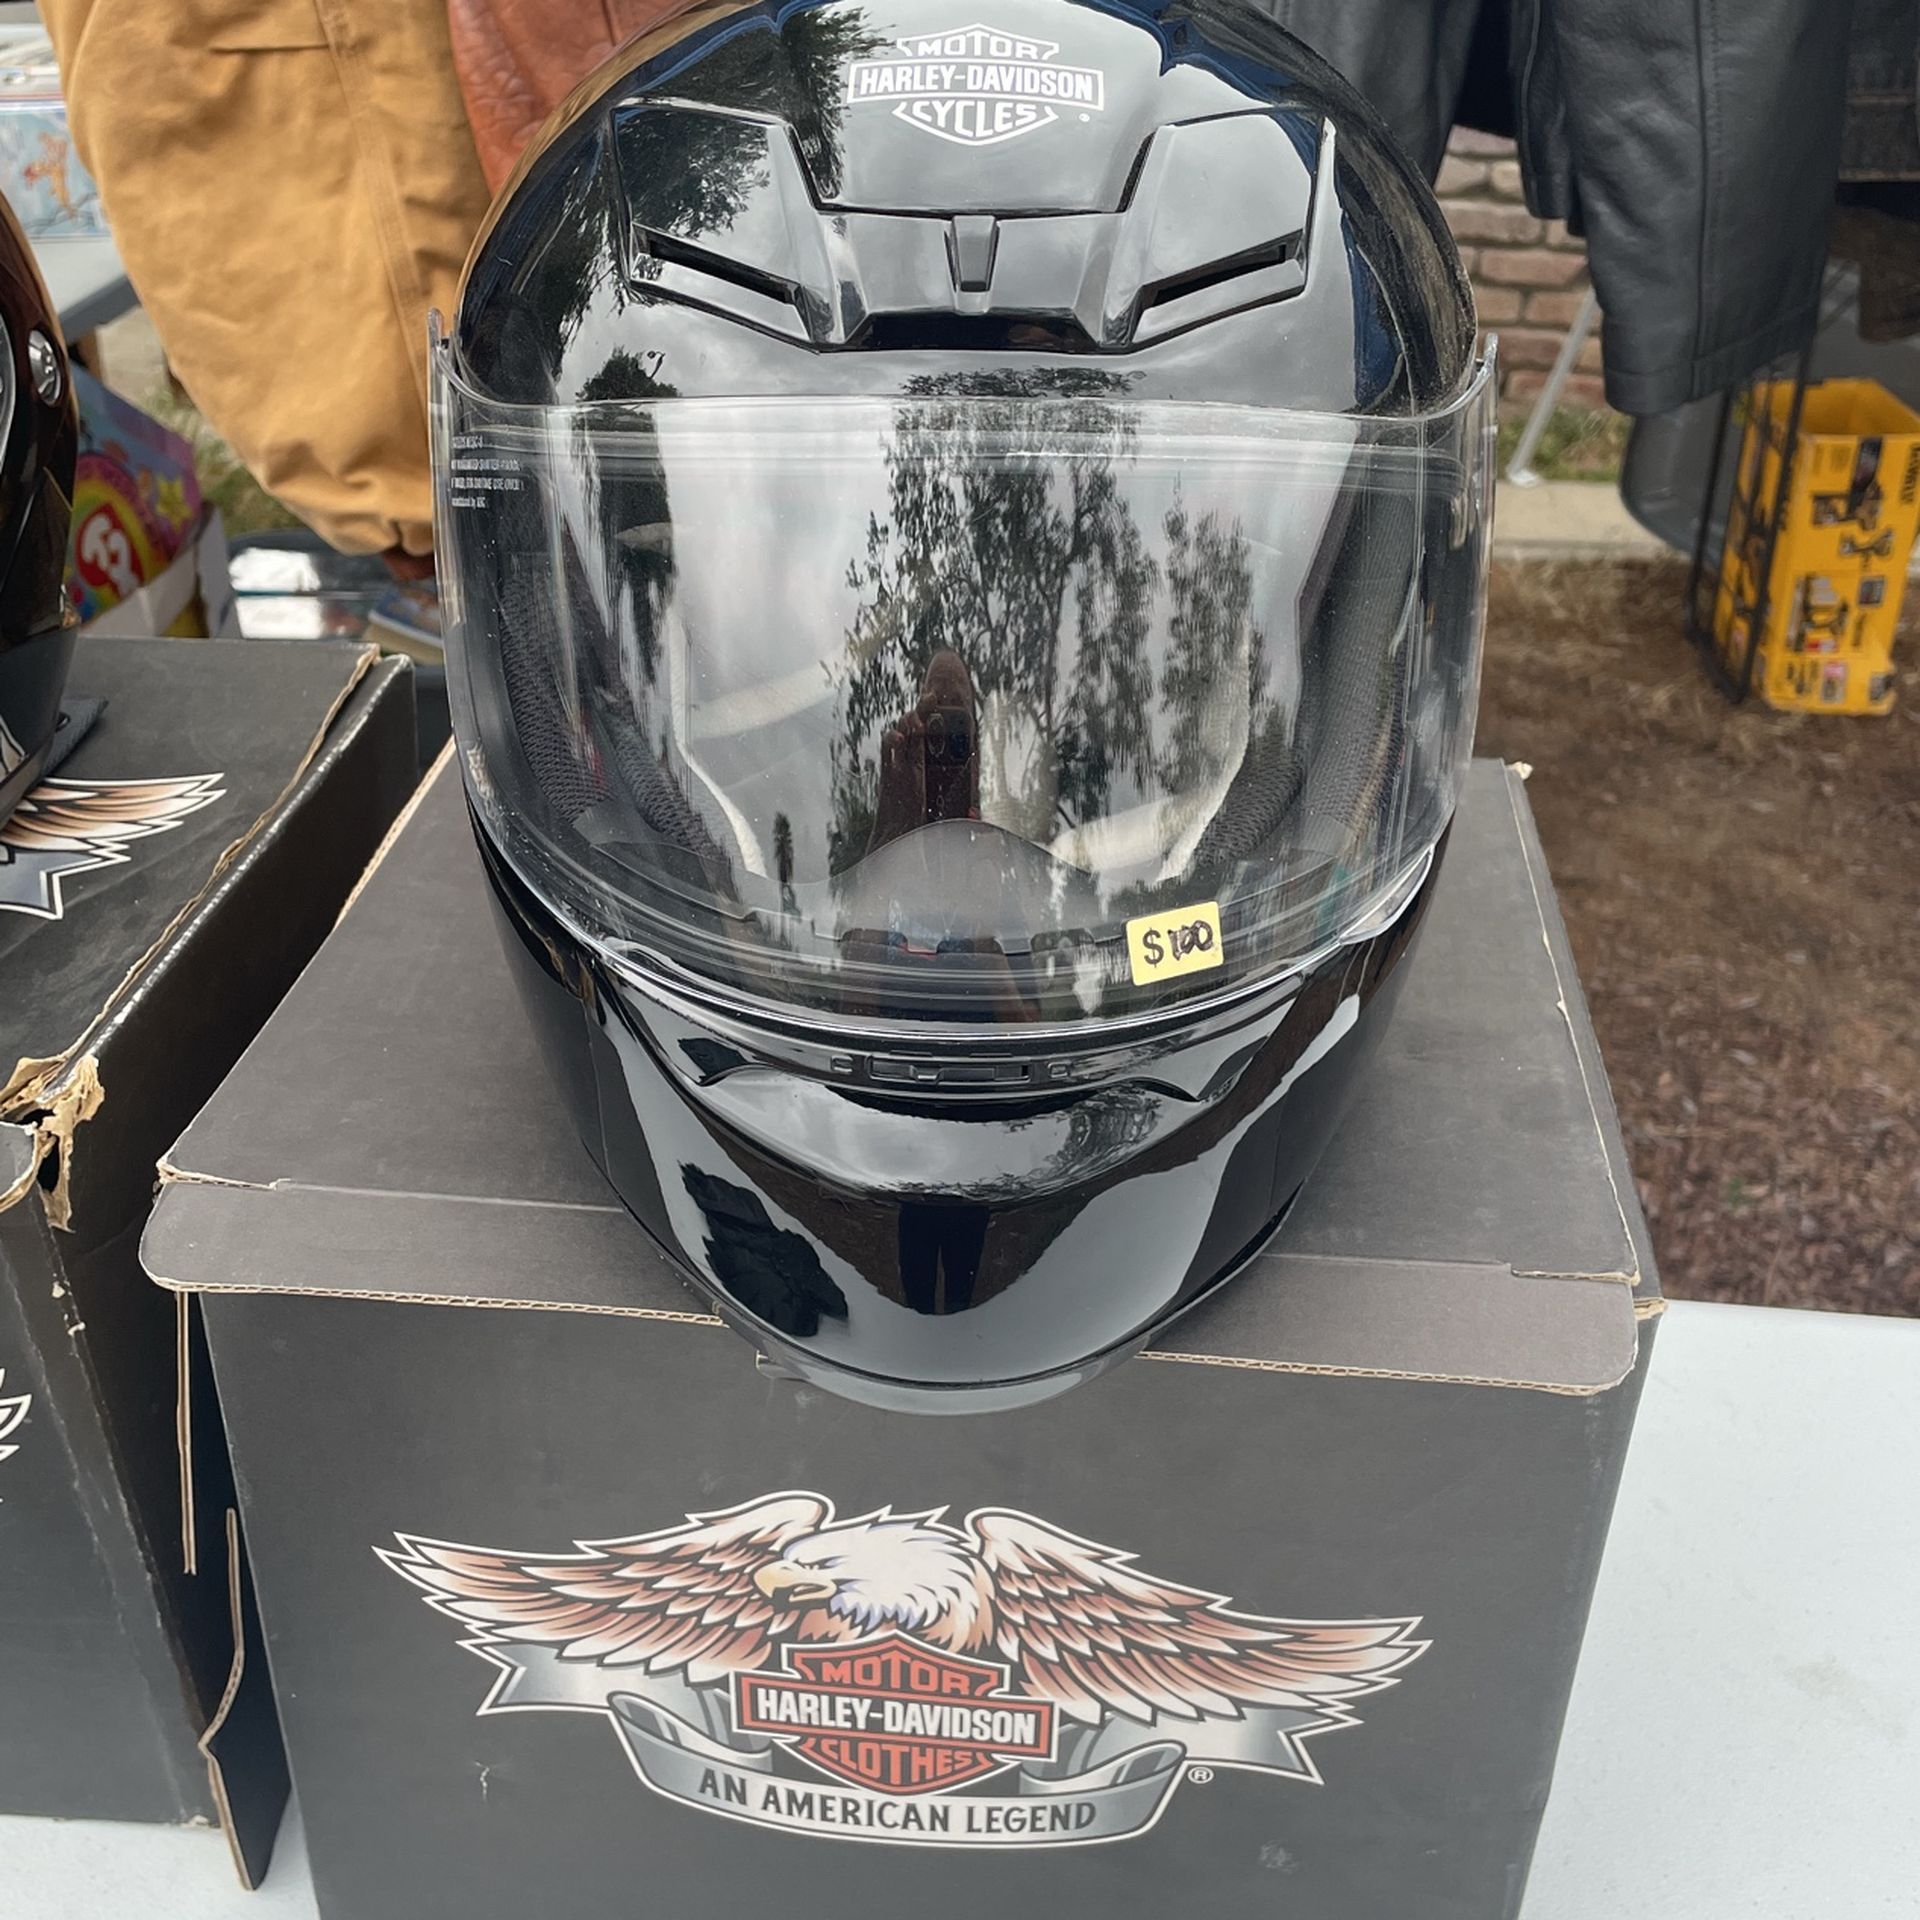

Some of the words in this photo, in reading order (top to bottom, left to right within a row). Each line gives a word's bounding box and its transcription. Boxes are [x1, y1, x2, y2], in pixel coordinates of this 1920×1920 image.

[917, 30, 1038, 58] MOTOR
[860, 64, 1093, 101] HARLEY-DAVIDSON
[911, 100, 1037, 138] CYCLES
[822, 1650, 970, 1695] MOTOR
[757, 1687, 1036, 1745] HARLEY-DAVIDSON
[820, 1738, 975, 1786] CLOTHES
[699, 1768, 748, 1805] AN
[761, 1784, 951, 1833] AMERICAN
[966, 1801, 1098, 1834] LEGEND
